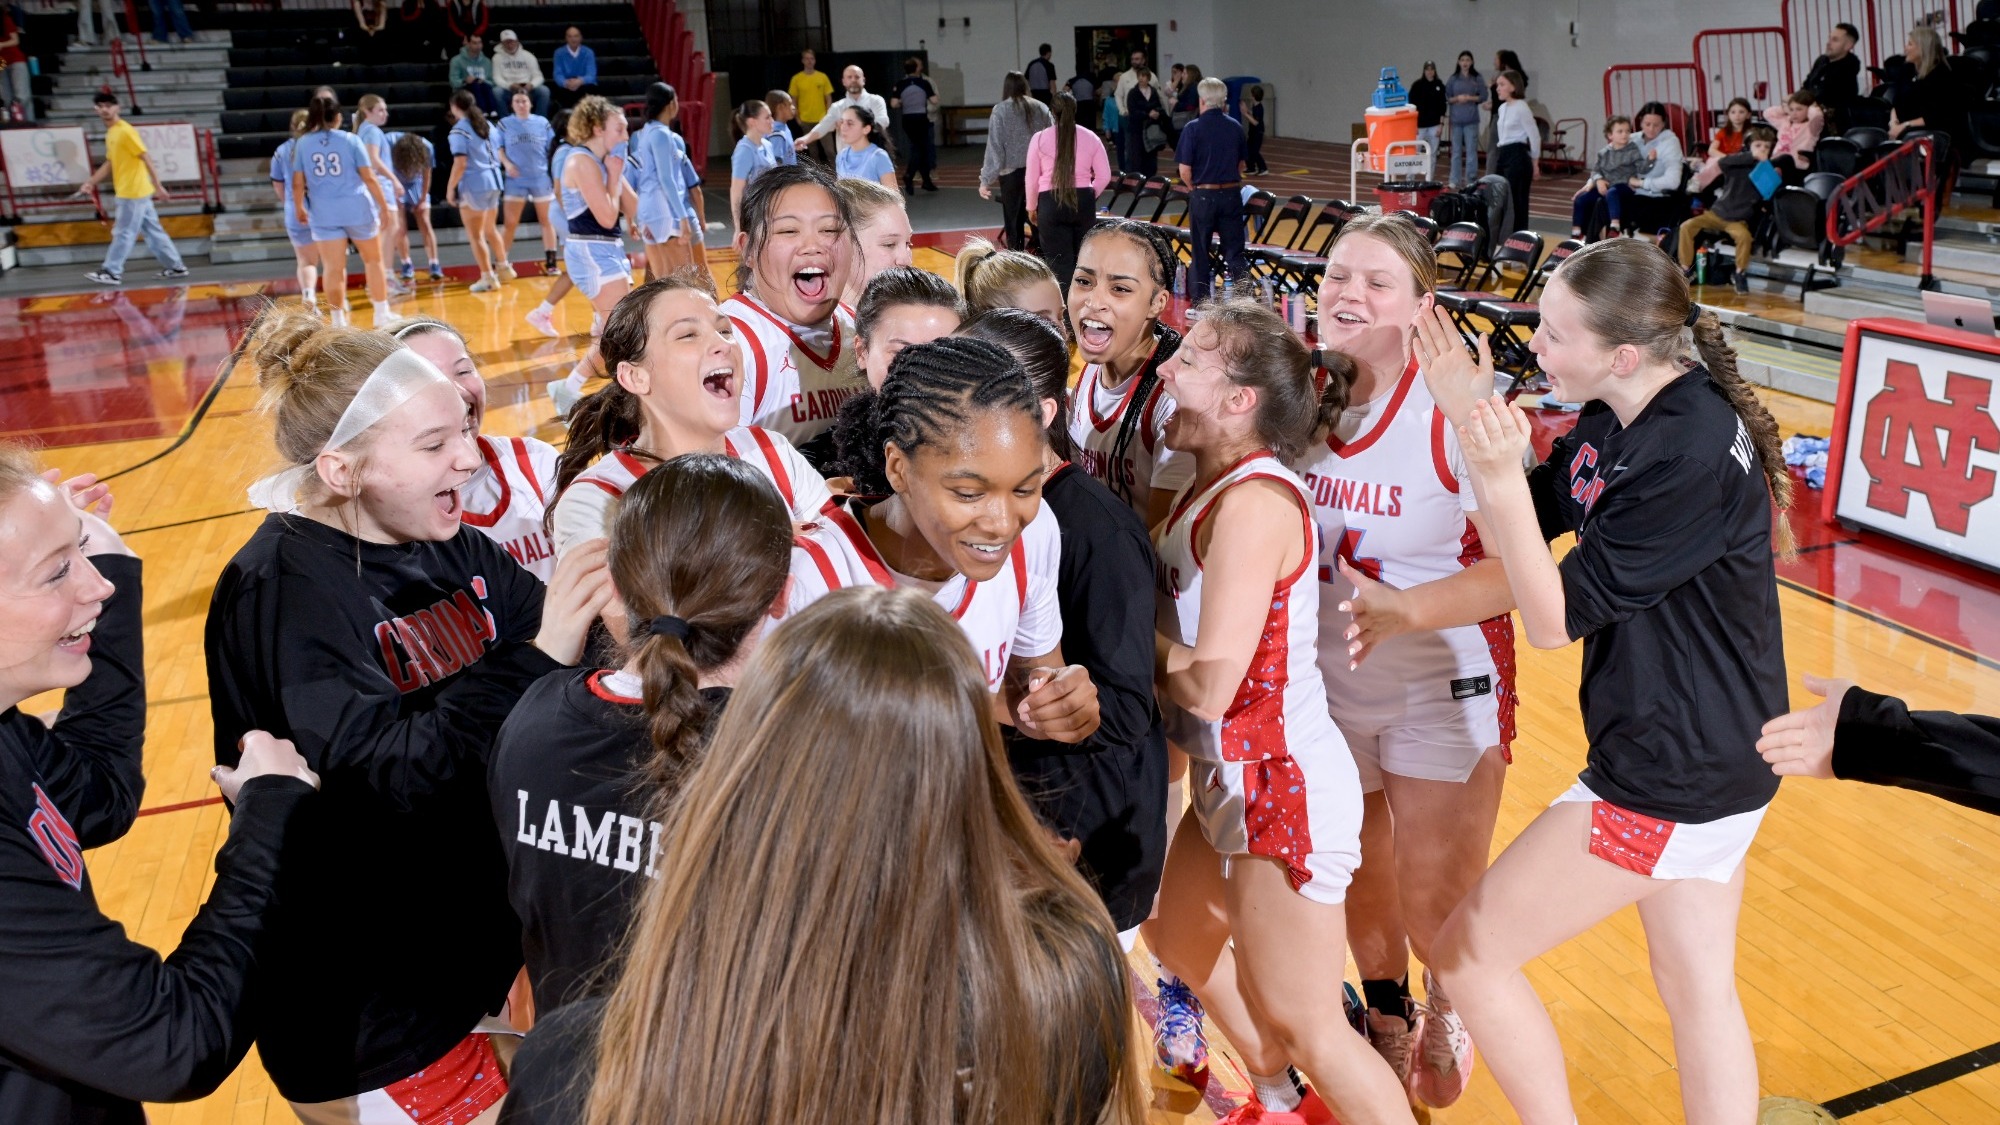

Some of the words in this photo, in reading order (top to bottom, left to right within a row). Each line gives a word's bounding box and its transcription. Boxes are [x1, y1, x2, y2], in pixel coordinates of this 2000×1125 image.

[312, 152, 342, 177] 33
[1394, 160, 1423, 168] GATORADE
[1503, 238, 1534, 252] CARDINALS
[791, 386, 859, 423] CARDI
[1296, 471, 1402, 517] RDINALS
[1477, 682, 1488, 690] XL
